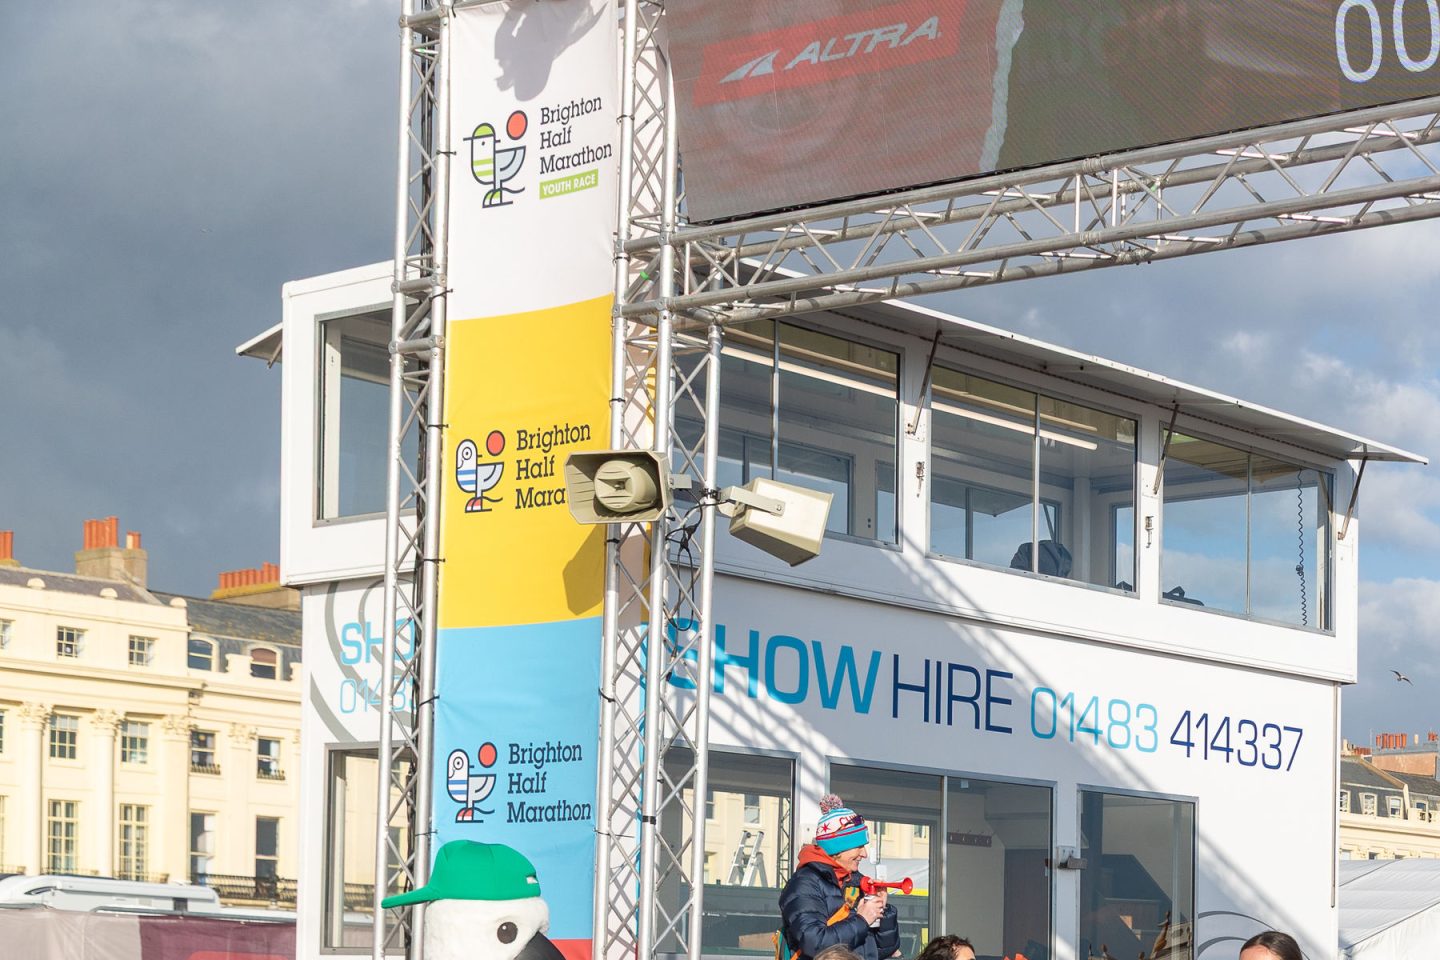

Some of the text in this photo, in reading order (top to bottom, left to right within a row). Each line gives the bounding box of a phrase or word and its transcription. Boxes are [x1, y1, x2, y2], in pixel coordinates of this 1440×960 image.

[783, 15, 940, 71] ALTRA
[540, 97, 602, 125] Brighton
[540, 126, 572, 150] Half
[540, 143, 612, 174] Marathon
[543, 174, 596, 196] YOUTH RACE
[516, 423, 591, 453] Brighton
[515, 455, 555, 481] Half
[514, 487, 566, 510] Mara
[667, 617, 1304, 772] SHOW HIRE 01483 414337
[508, 741, 583, 769] Brighton
[507, 771, 547, 794] Half
[506, 800, 592, 823] Marathon
